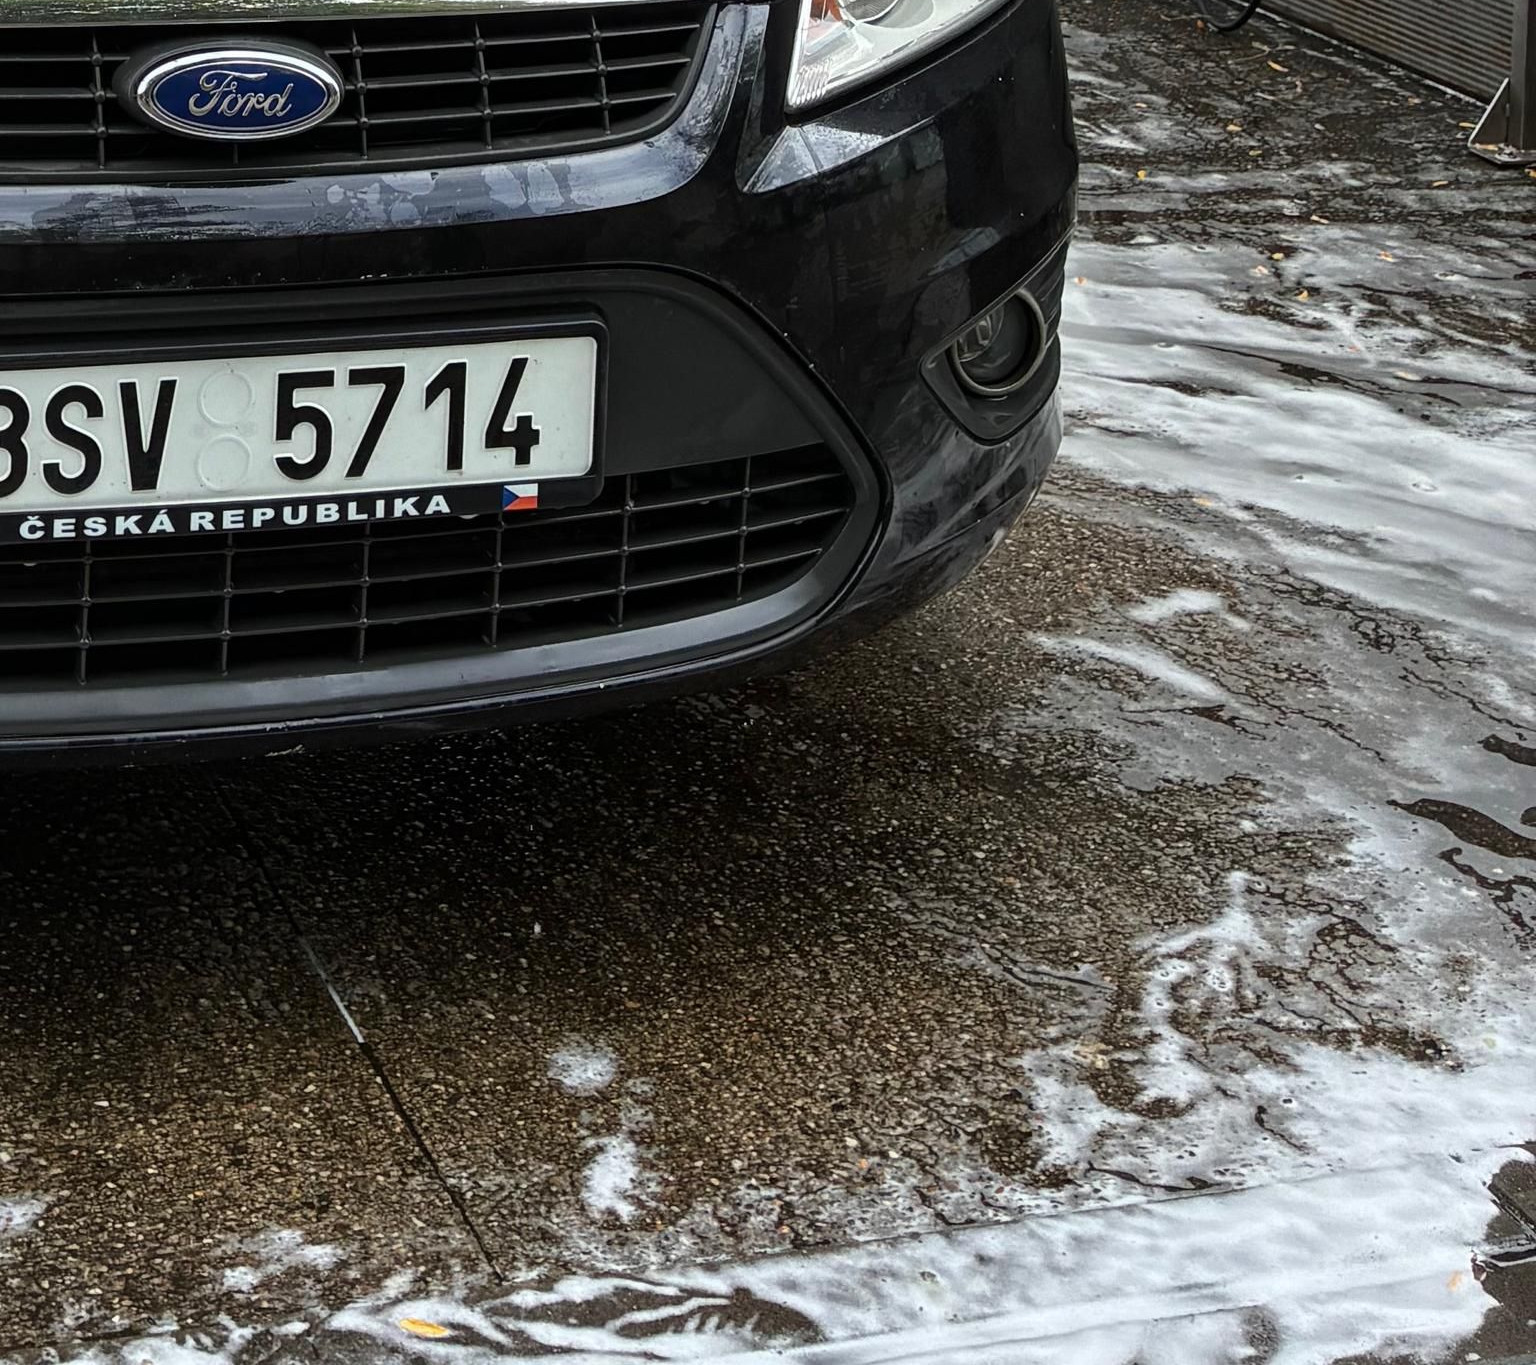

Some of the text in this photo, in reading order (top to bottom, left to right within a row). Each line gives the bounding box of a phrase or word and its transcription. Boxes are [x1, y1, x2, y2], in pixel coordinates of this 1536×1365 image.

[188, 69, 294, 118] Ford
[273, 354, 542, 482] 5714
[18, 493, 452, 541] ČESKÁ REPUBLIKA
